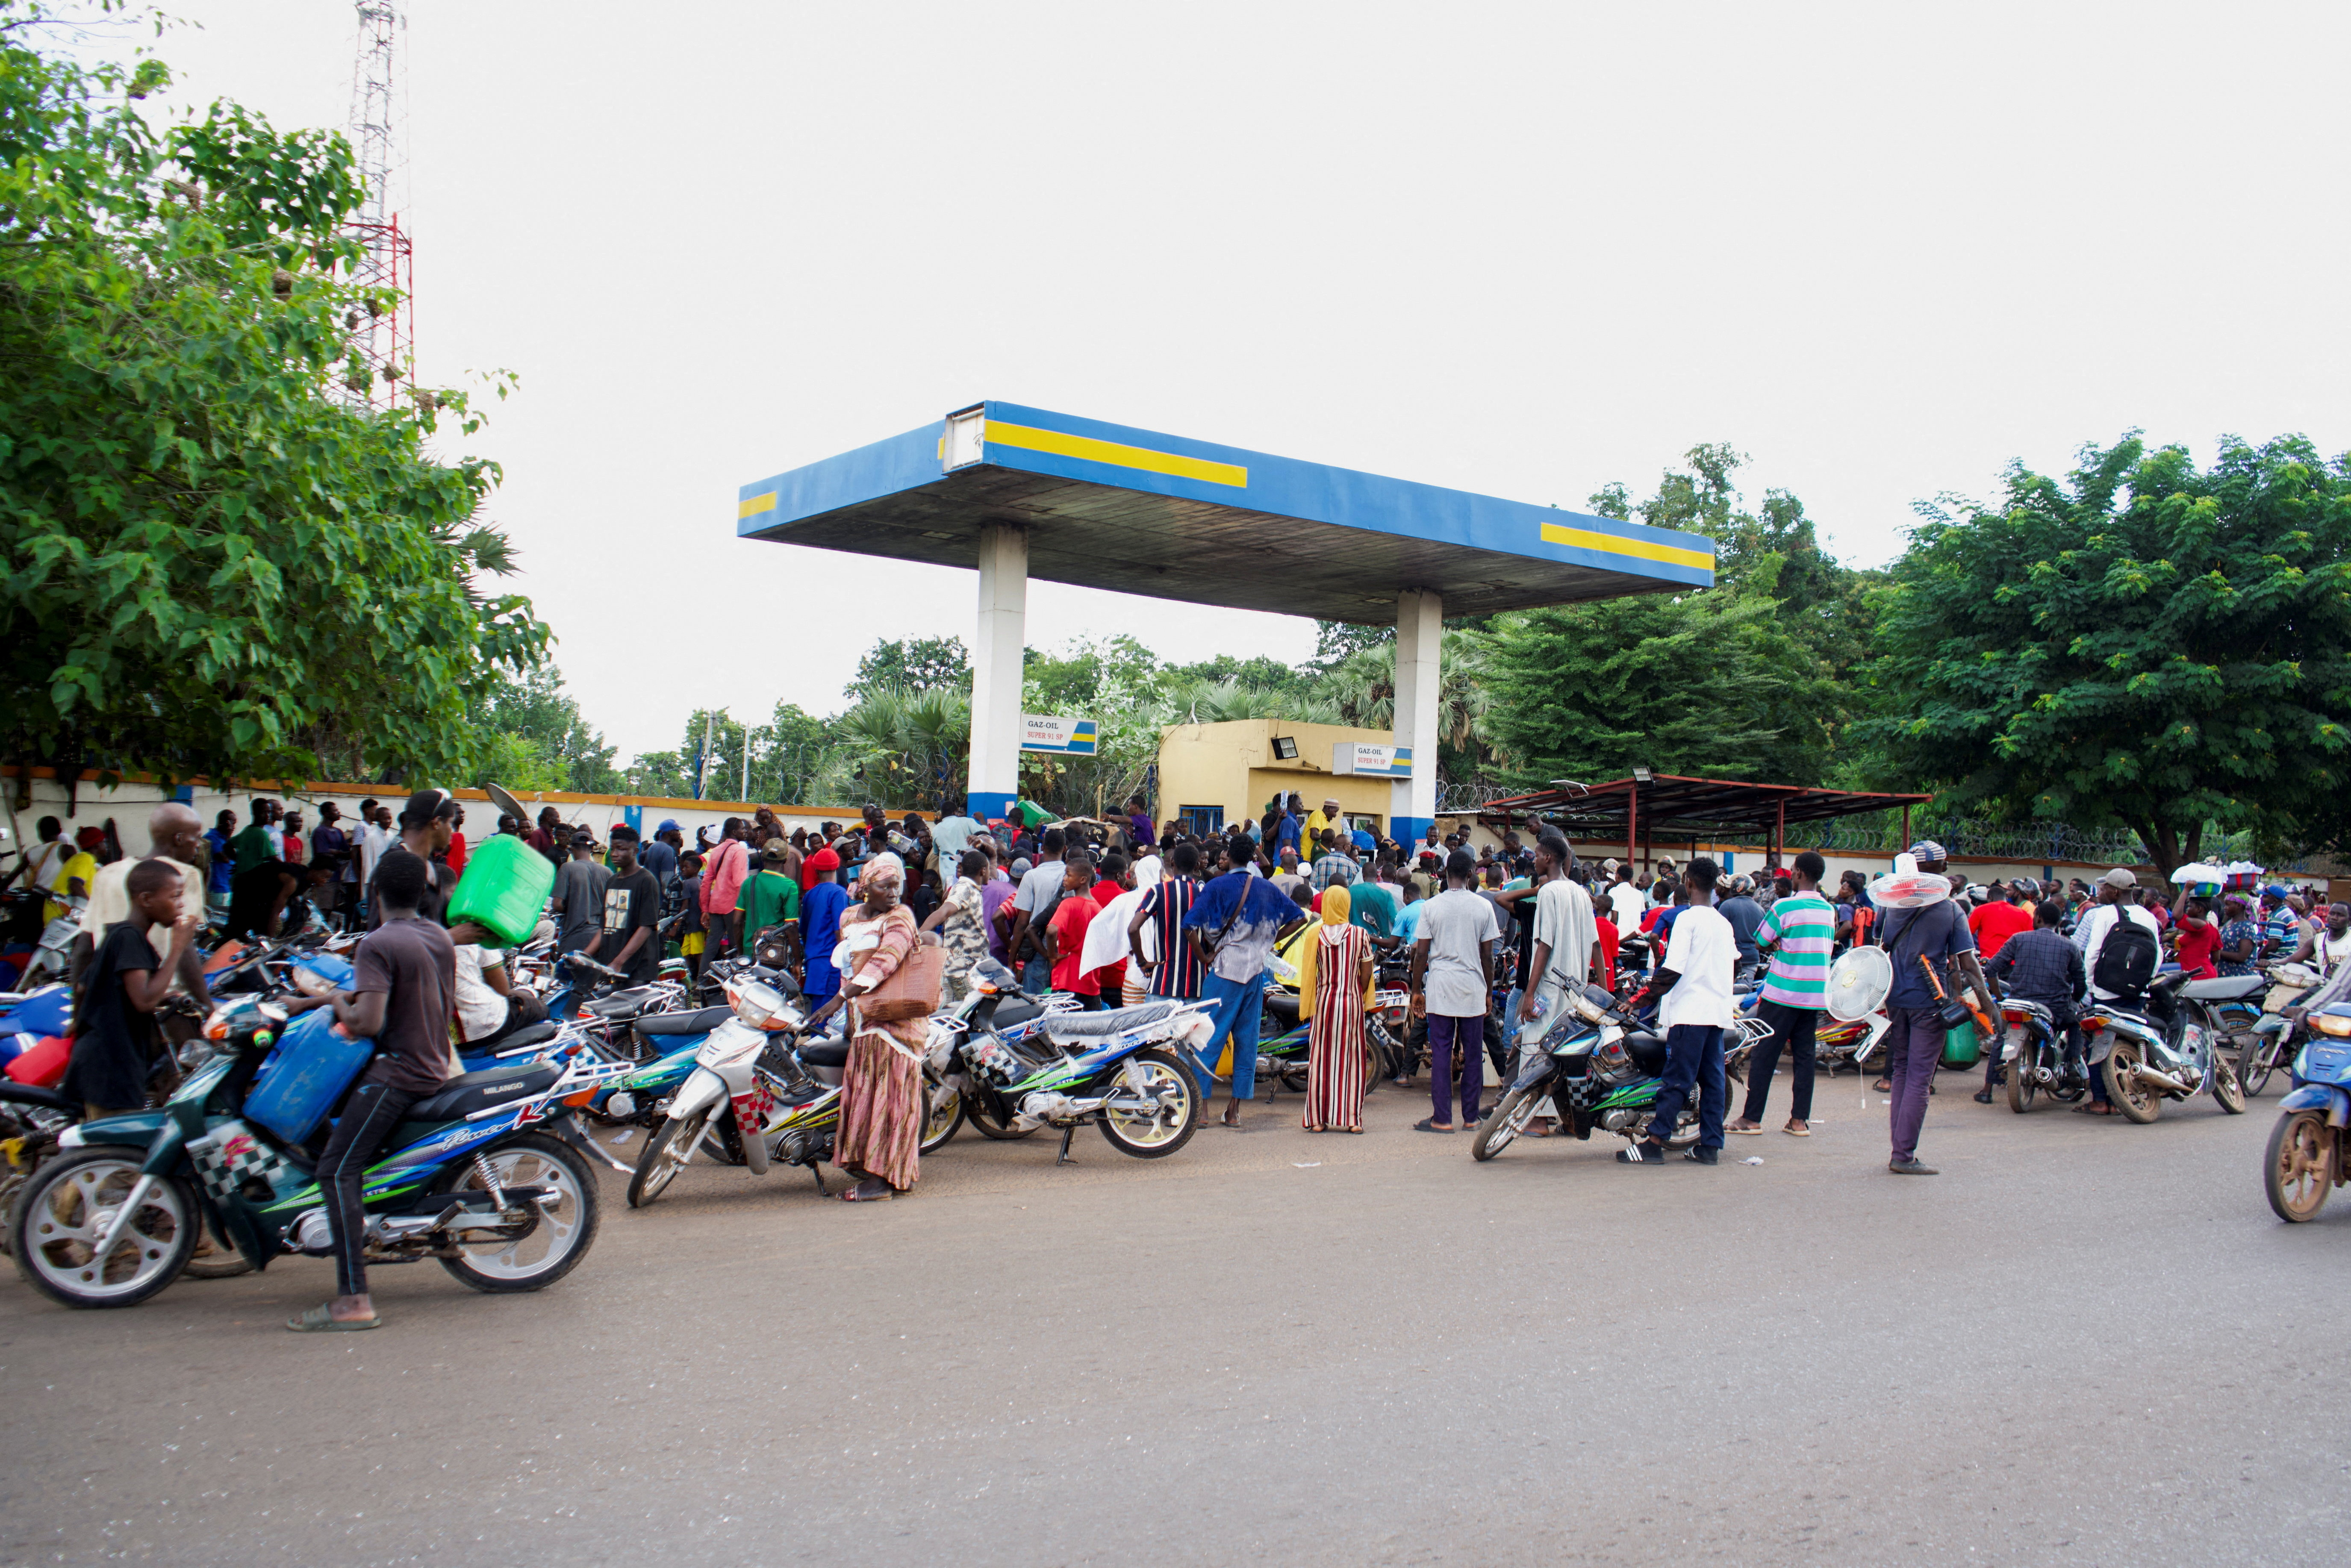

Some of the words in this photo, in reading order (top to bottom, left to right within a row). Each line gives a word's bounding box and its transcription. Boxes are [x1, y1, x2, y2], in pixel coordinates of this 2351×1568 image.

[1028, 721, 1058, 729] GAZ-OIL
[483, 1081, 525, 1094] MILANGO
[439, 1121, 513, 1151] Power
[367, 1186, 389, 1197] KTM
